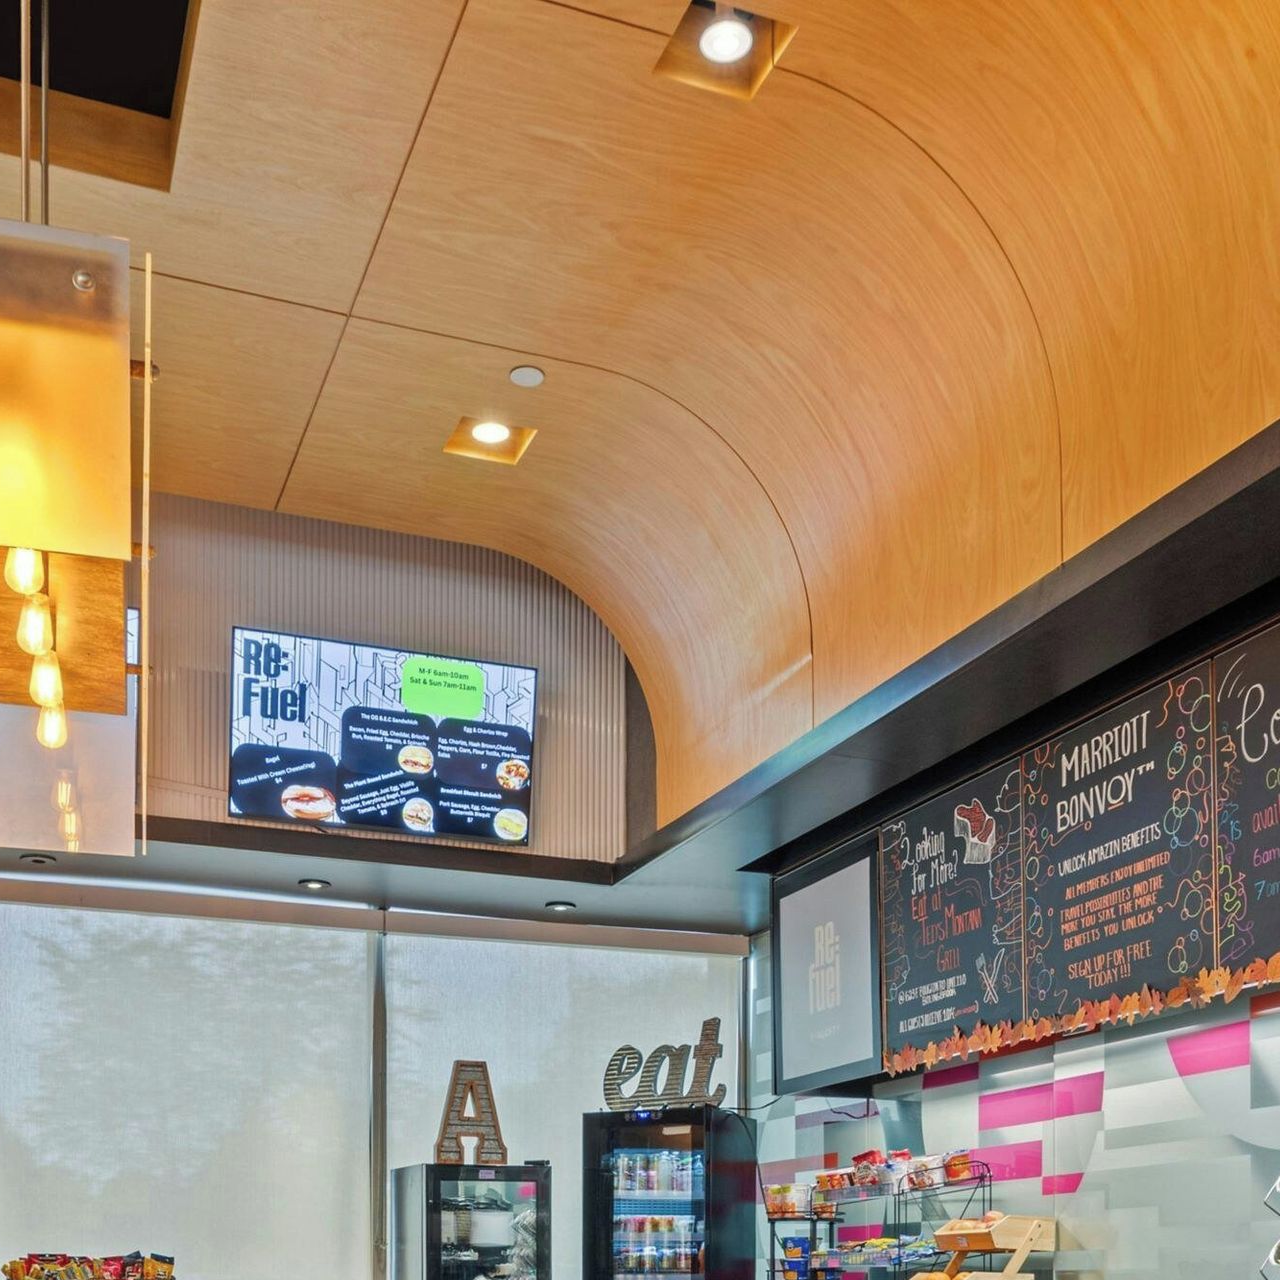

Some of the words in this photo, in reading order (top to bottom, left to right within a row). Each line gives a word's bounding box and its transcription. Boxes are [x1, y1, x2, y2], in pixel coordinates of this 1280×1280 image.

[241, 677, 307, 723] Fuel
[1061, 710, 1151, 787] MARRIOTT
[1058, 852, 1087, 877] UNLOCK
[1122, 822, 1162, 853] BENEFITS
[1063, 929, 1101, 952] BENEFITS
[1104, 921, 1119, 937] YOU
[1122, 910, 1155, 932] UNLOCK
[1068, 960, 1091, 981] SIGN
[1094, 952, 1105, 970] UP
[1106, 948, 1125, 969] FOR
[1127, 939, 1153, 962] FREE
[603, 1017, 727, 1111] eat
[434, 1060, 508, 1166] A
